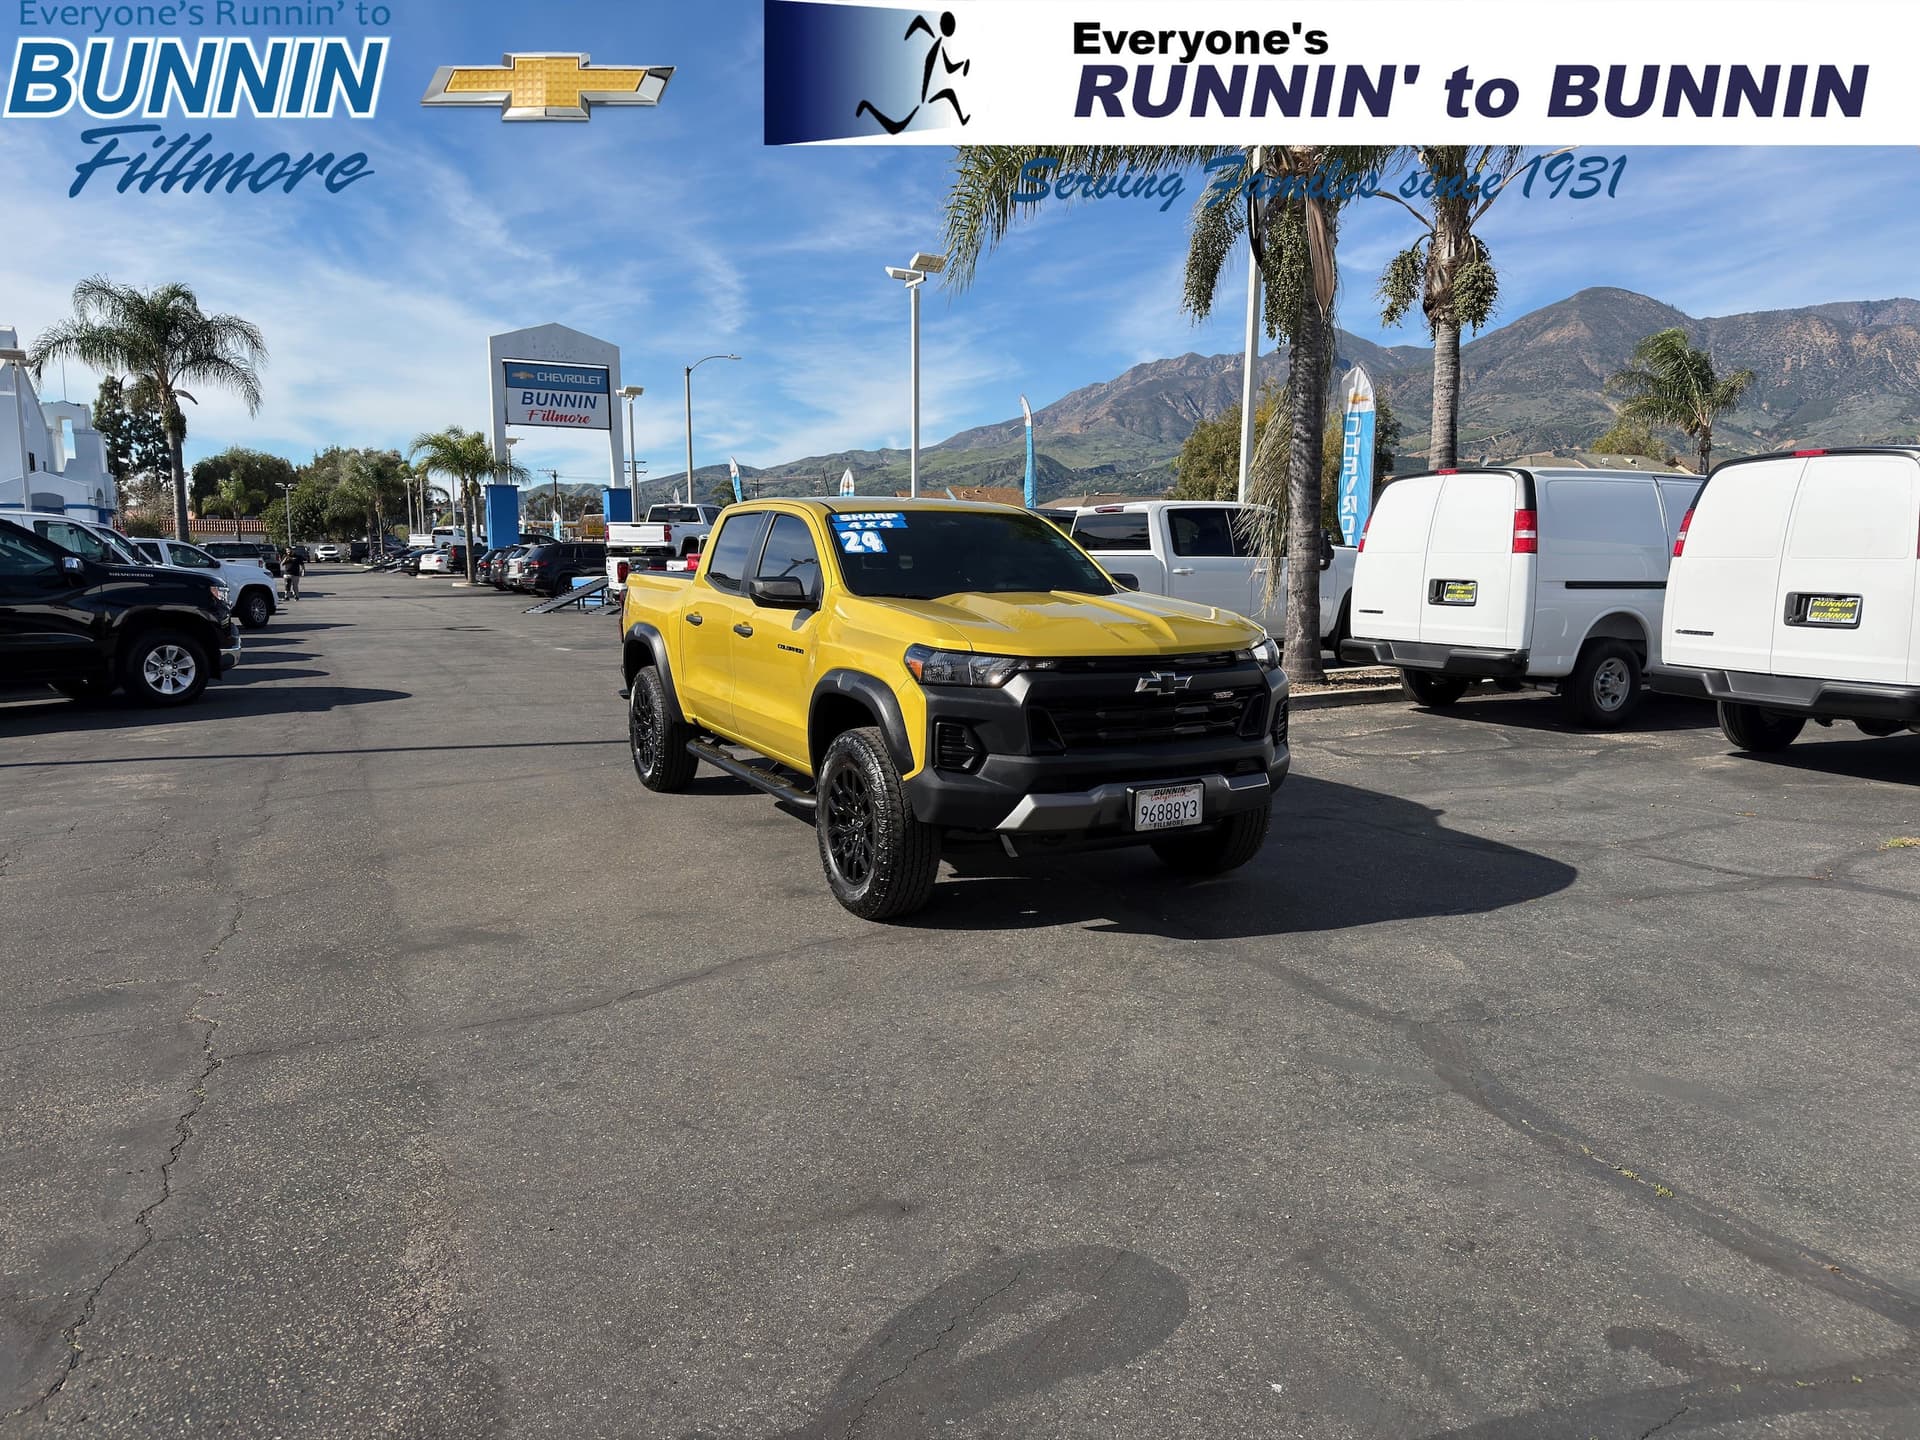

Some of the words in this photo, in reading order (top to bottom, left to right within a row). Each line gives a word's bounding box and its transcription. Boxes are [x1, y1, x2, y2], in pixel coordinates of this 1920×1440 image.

[537, 371, 602, 385] CHEVROLET
[521, 391, 597, 409] BUNNIN
[528, 409, 591, 424] Fillmore
[839, 512, 898, 521] SHARP
[840, 531, 883, 552] 24
[1154, 786, 1186, 796] BUNNIN
[1141, 800, 1197, 824] 96888Y3
